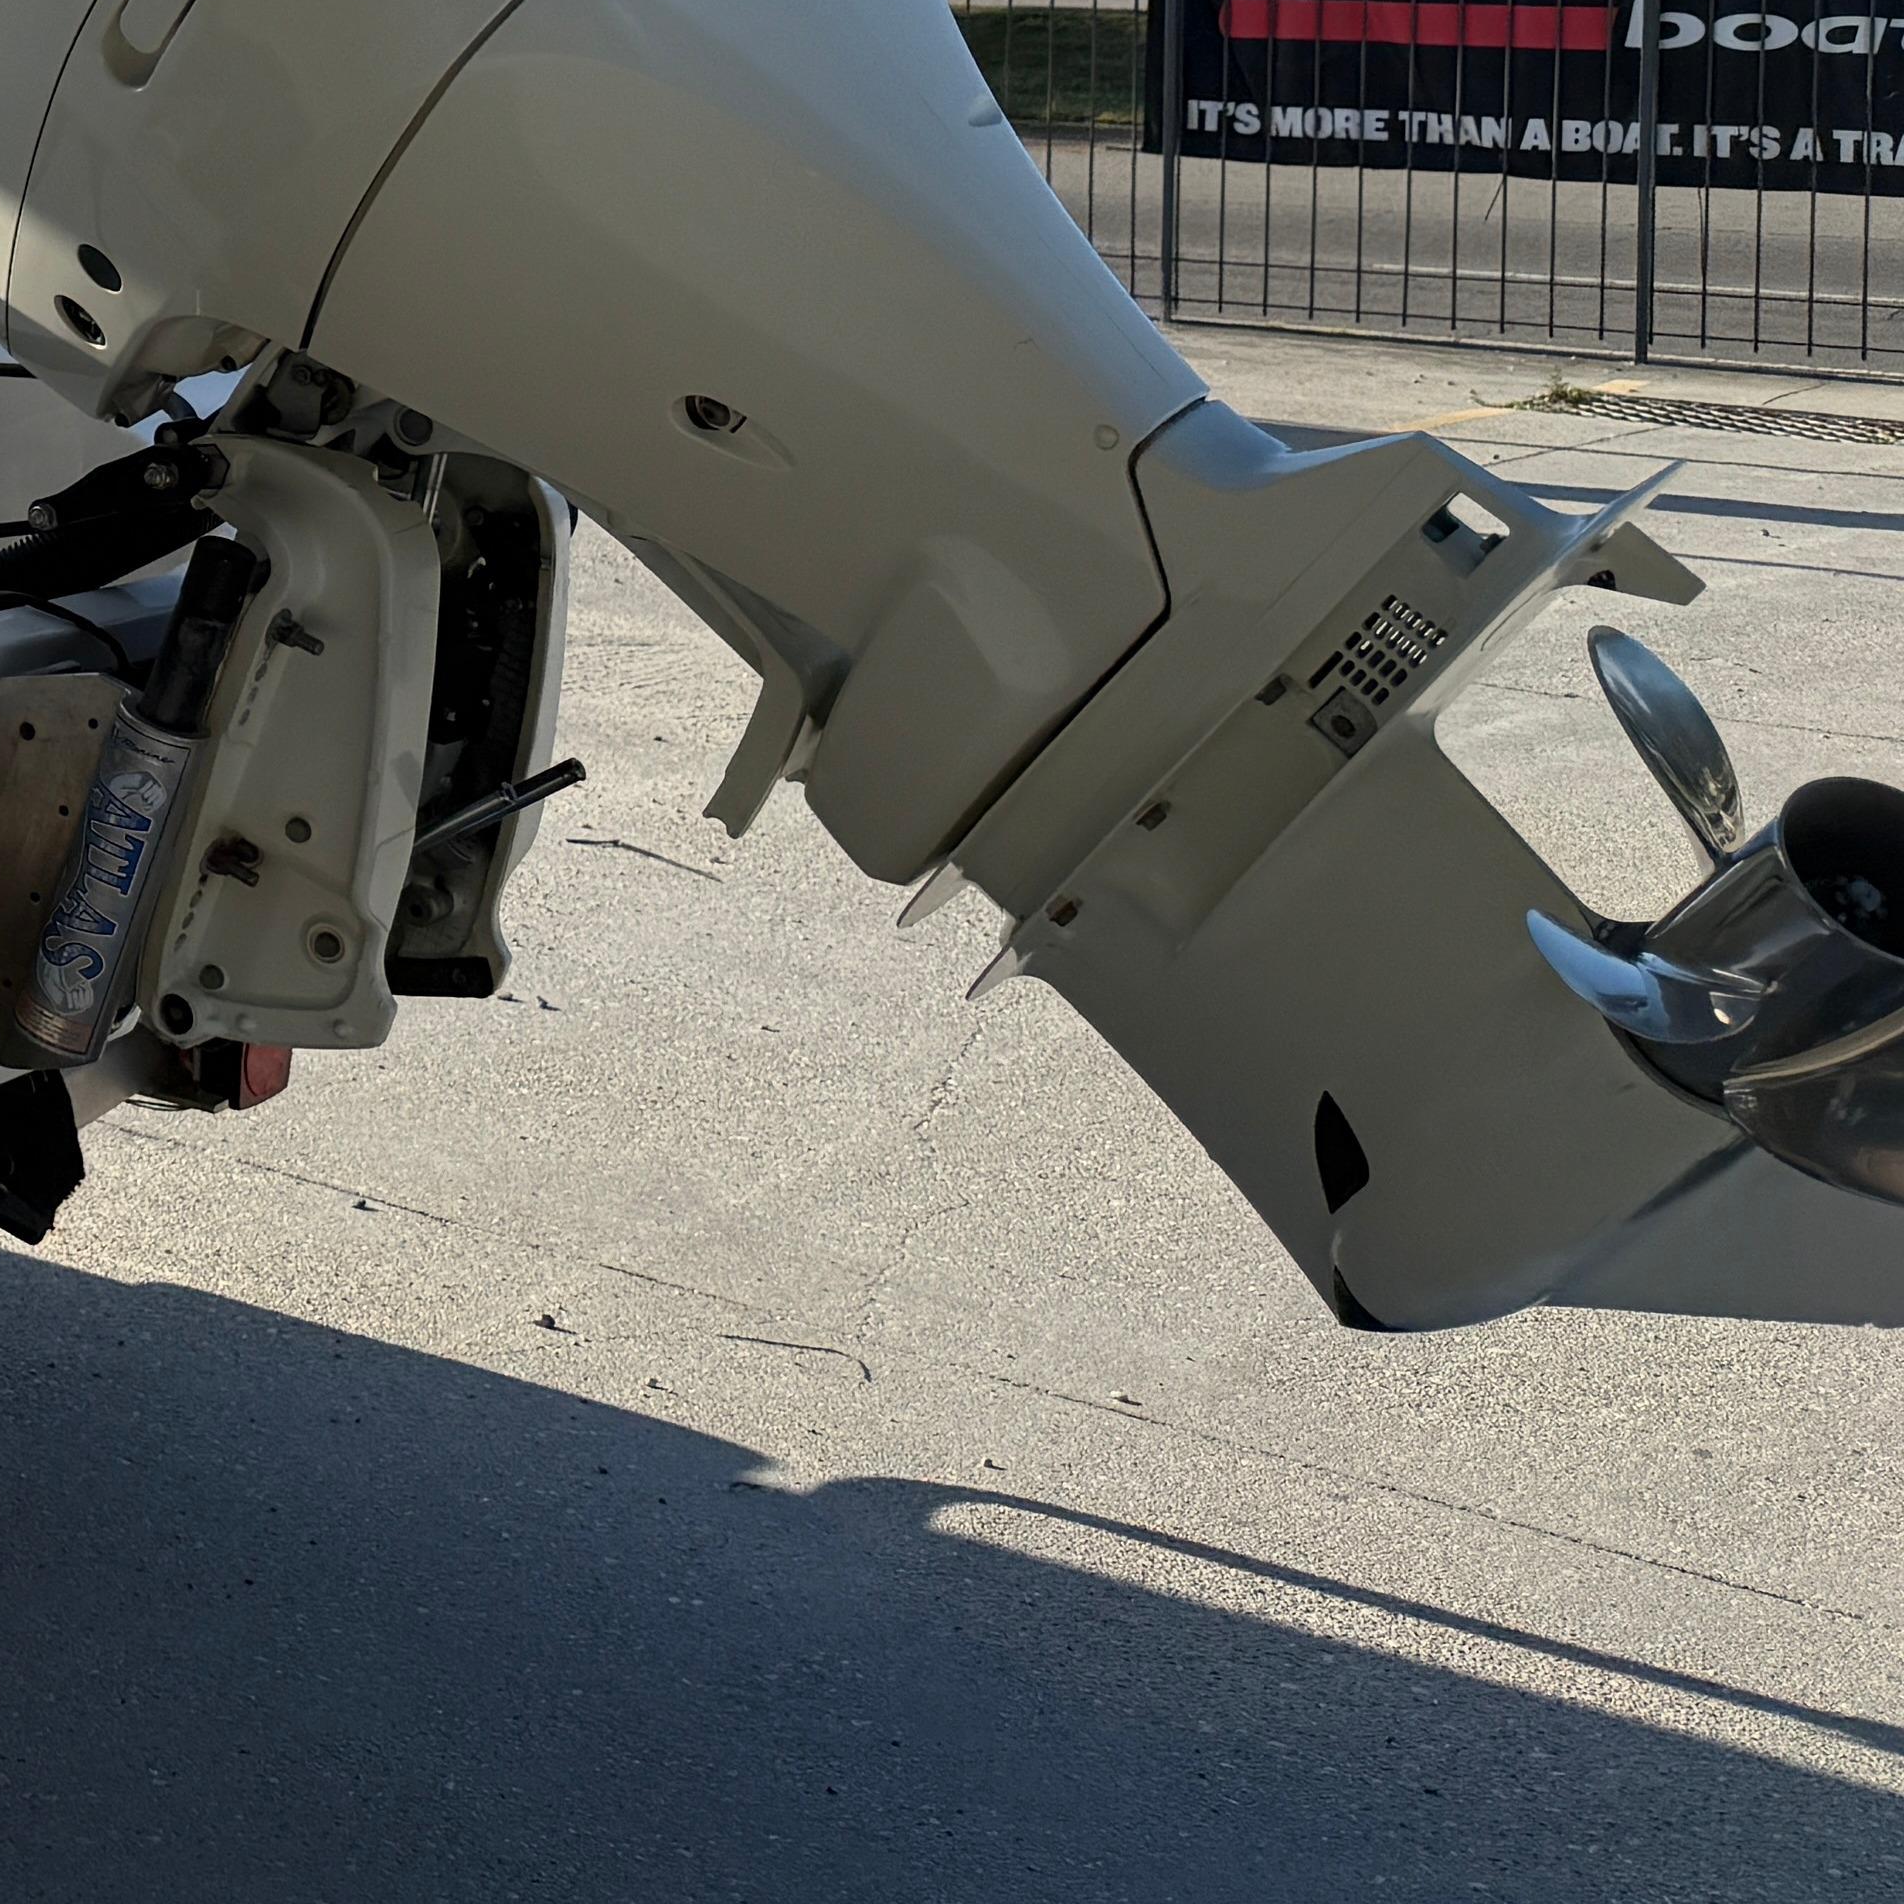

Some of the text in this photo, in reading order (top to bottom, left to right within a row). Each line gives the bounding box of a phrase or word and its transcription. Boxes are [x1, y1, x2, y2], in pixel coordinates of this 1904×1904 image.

[1269, 106, 1390, 141] MORE
[1398, 110, 1513, 150] THAN
[1519, 118, 1552, 152] A
[1562, 119, 1683, 158] BOAT.
[1789, 127, 1825, 163] A
[40, 782, 154, 983] ATLAS
